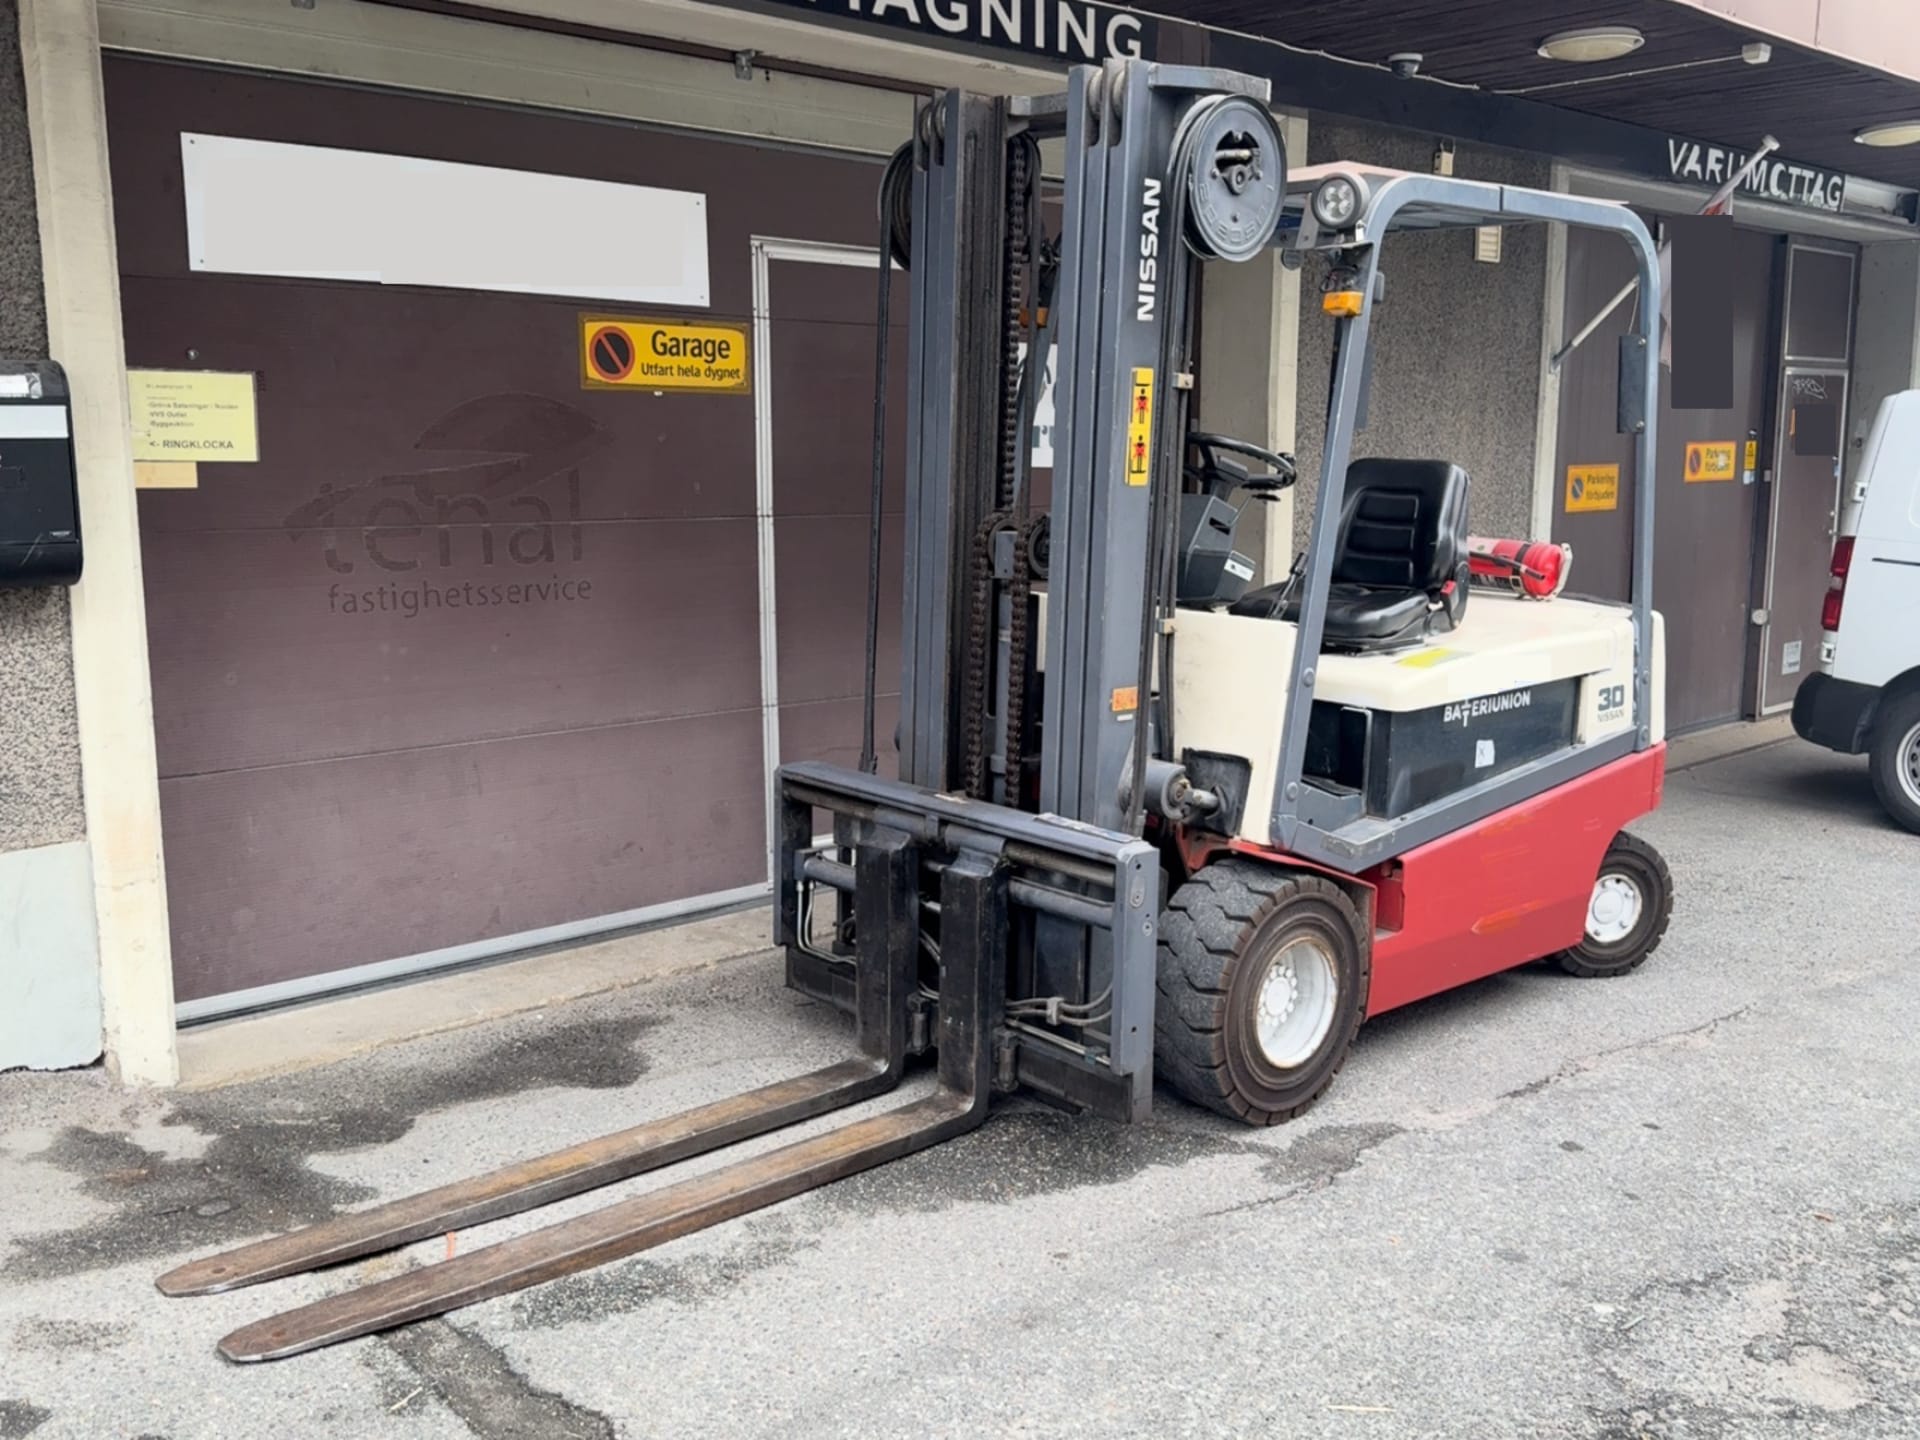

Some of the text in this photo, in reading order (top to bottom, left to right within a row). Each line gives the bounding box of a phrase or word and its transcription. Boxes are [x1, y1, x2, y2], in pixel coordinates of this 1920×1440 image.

[804, 0, 1143, 61] GNING
[1136, 178, 1162, 321] NISSAN
[652, 330, 731, 364] Garage
[641, 363, 741, 381] Utfart hela dygnet
[163, 440, 234, 449] RINGKLOCKA
[328, 574, 592, 618] fastighetsservice
[1598, 685, 1625, 712] 30
[1597, 709, 1625, 723] NISSAN
